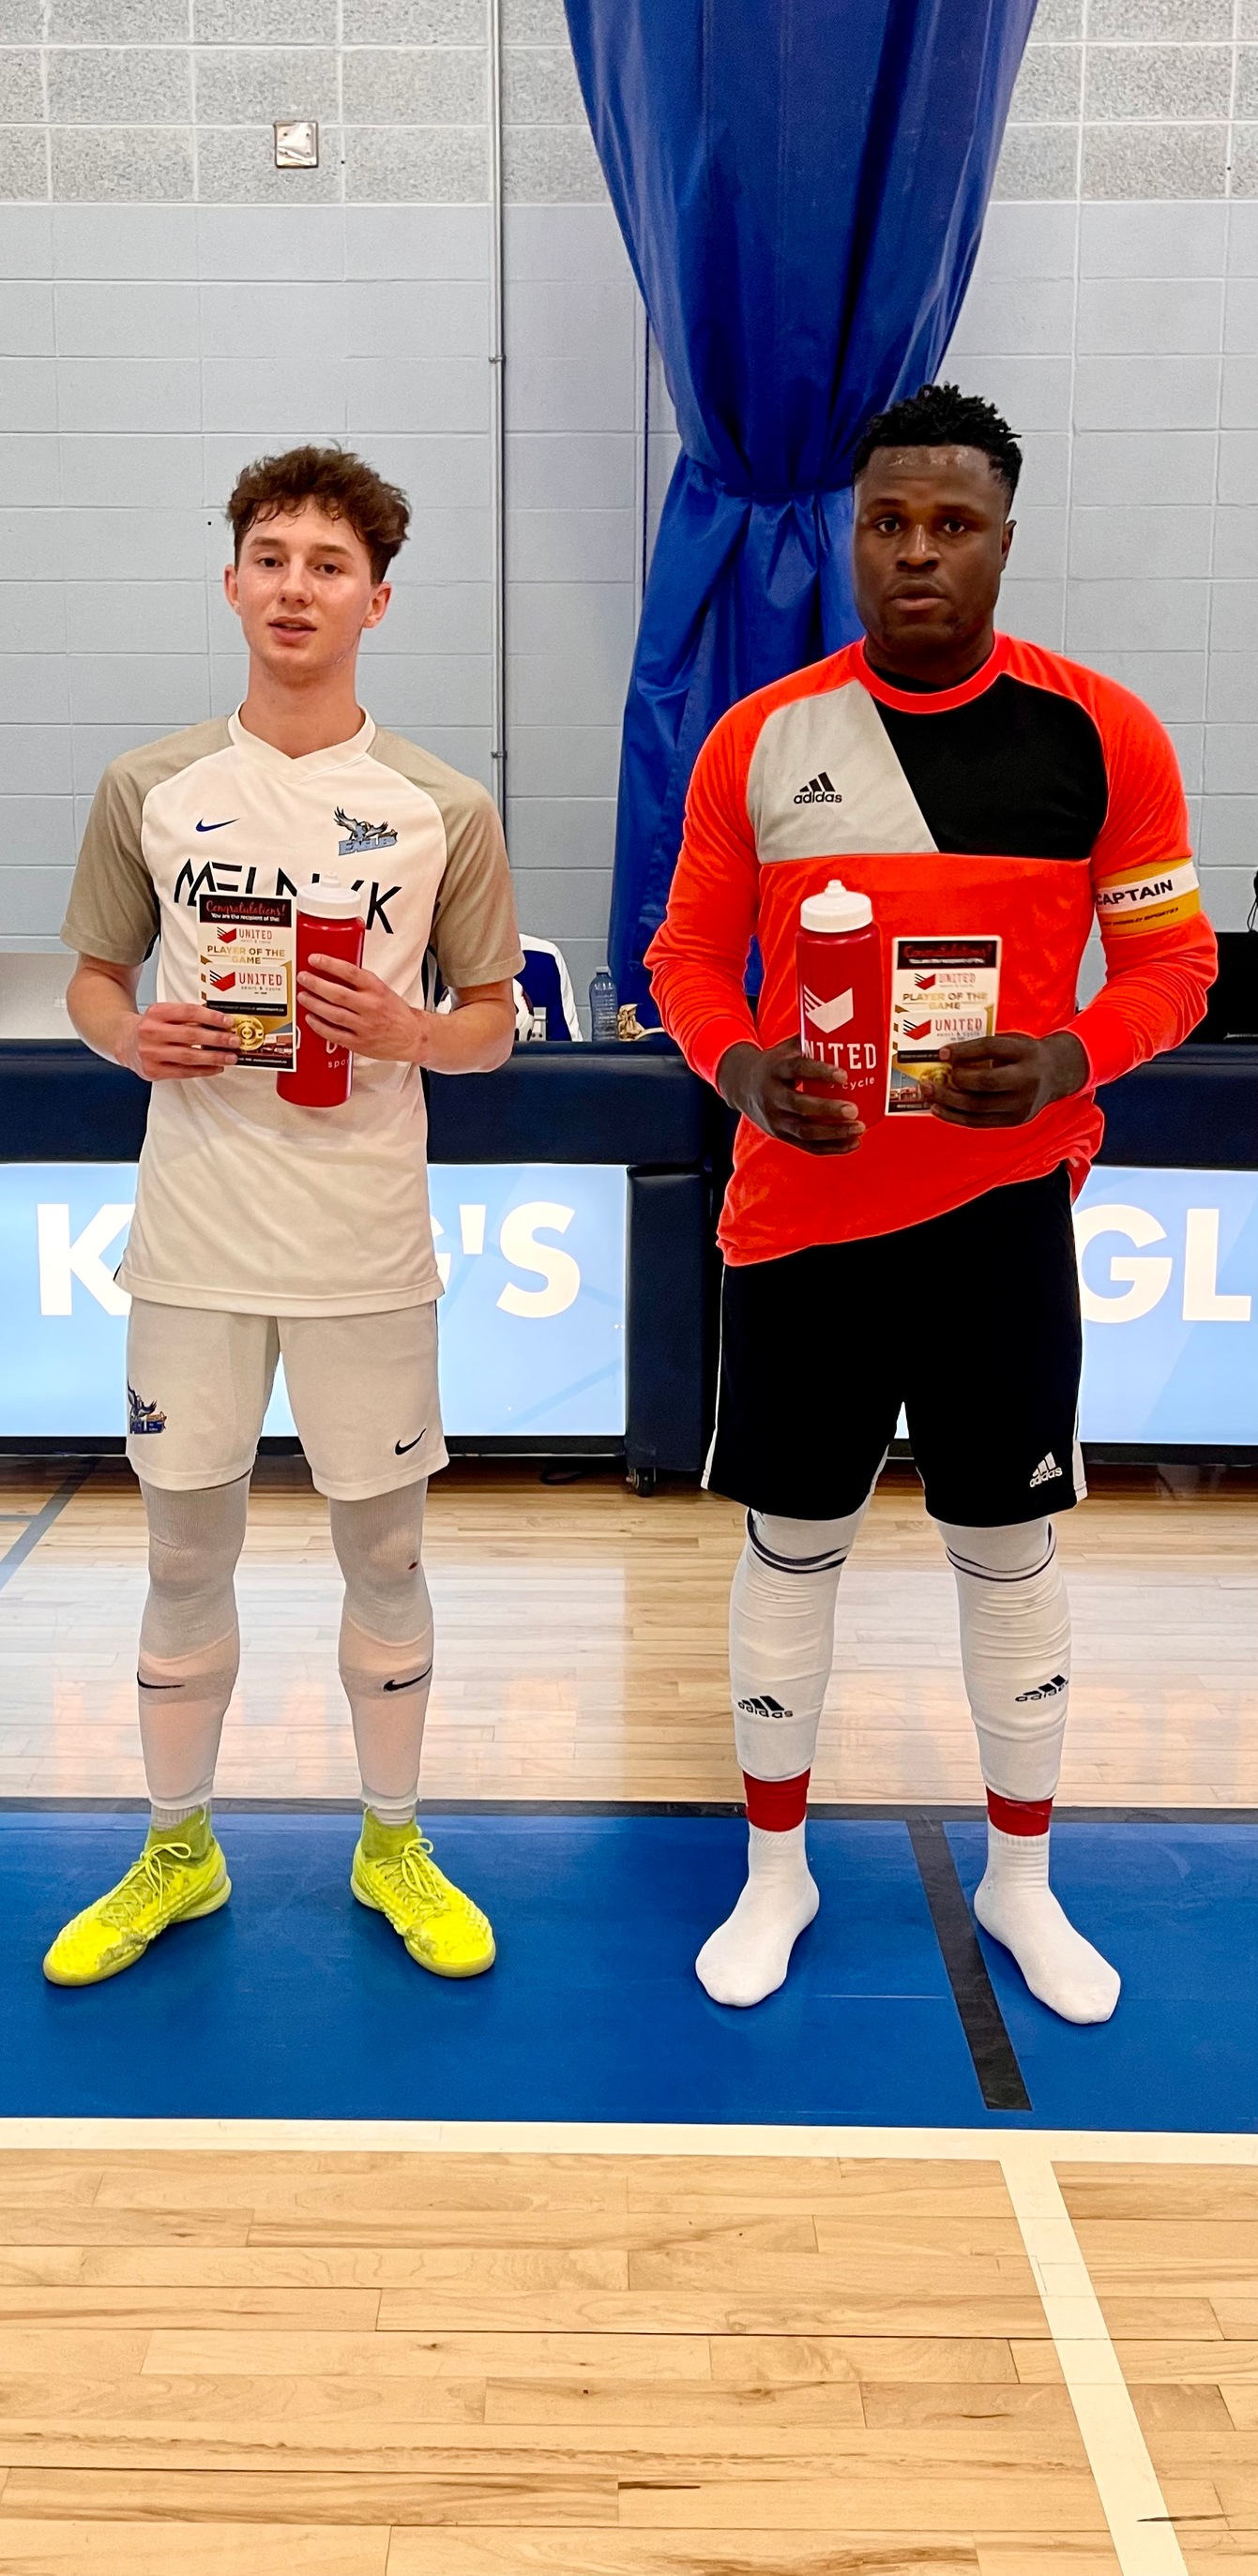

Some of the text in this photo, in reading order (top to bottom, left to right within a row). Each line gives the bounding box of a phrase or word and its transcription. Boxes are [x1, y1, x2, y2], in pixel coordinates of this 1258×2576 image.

[794, 791, 842, 804] adidas
[1097, 879, 1173, 906] CAPTAIN
[206, 900, 286, 916] Congratulations!
[207, 945, 285, 957] PLAYER OF THE
[1029, 1467, 1063, 1487] adidas
[738, 1702, 793, 1718] adidas
